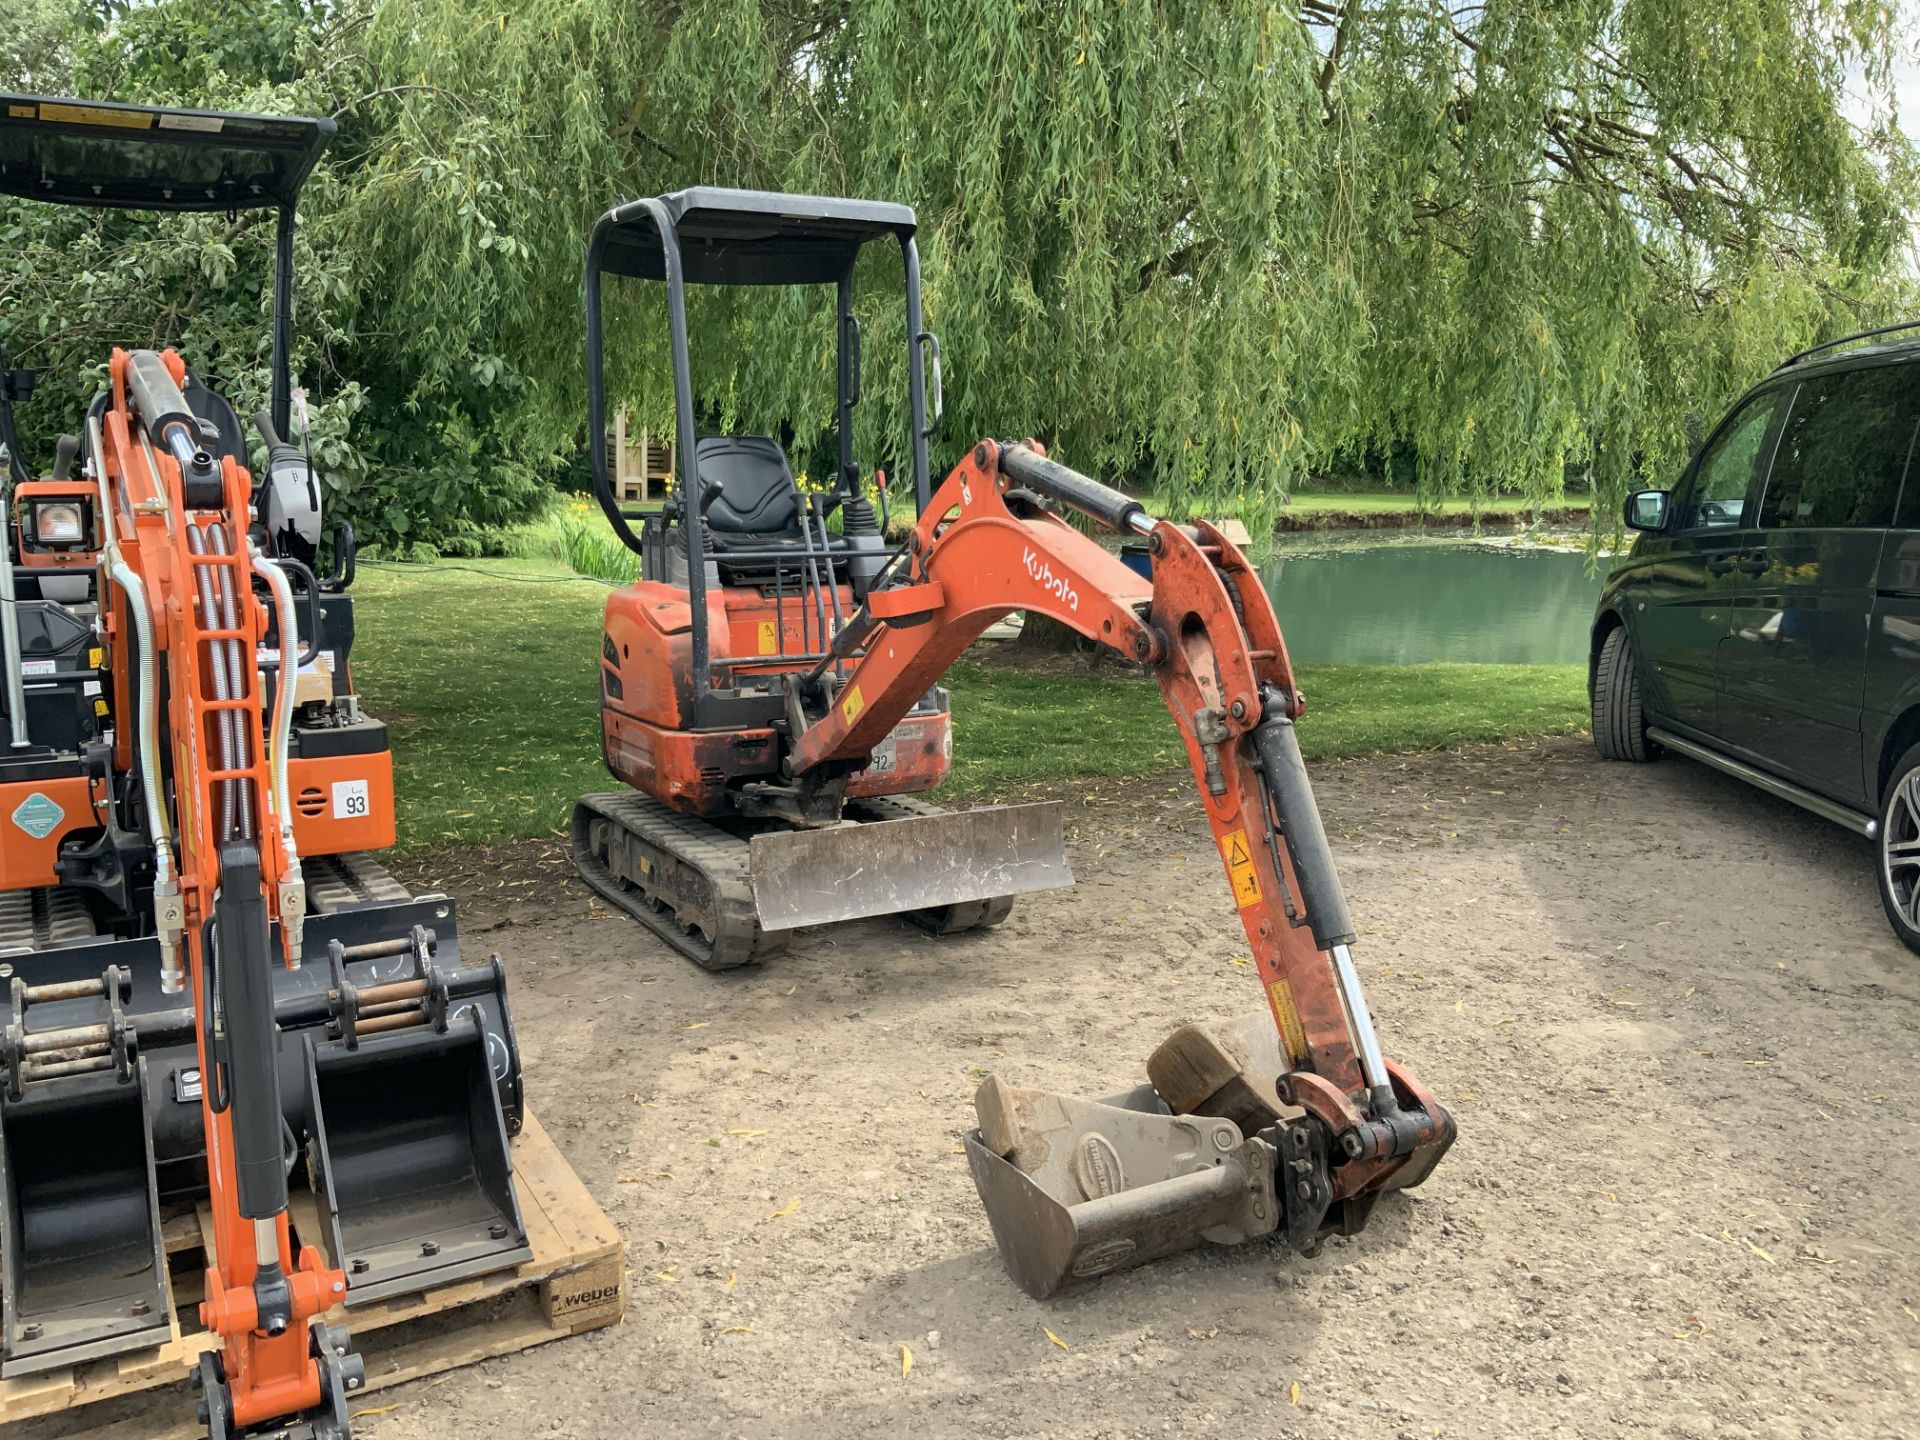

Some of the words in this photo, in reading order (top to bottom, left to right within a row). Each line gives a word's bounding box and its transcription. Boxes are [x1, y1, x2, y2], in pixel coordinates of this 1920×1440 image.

[1023, 546, 1078, 612] Kubota
[873, 755, 888, 770] 92
[346, 796, 366, 814] 93
[565, 1284, 620, 1307] weber
